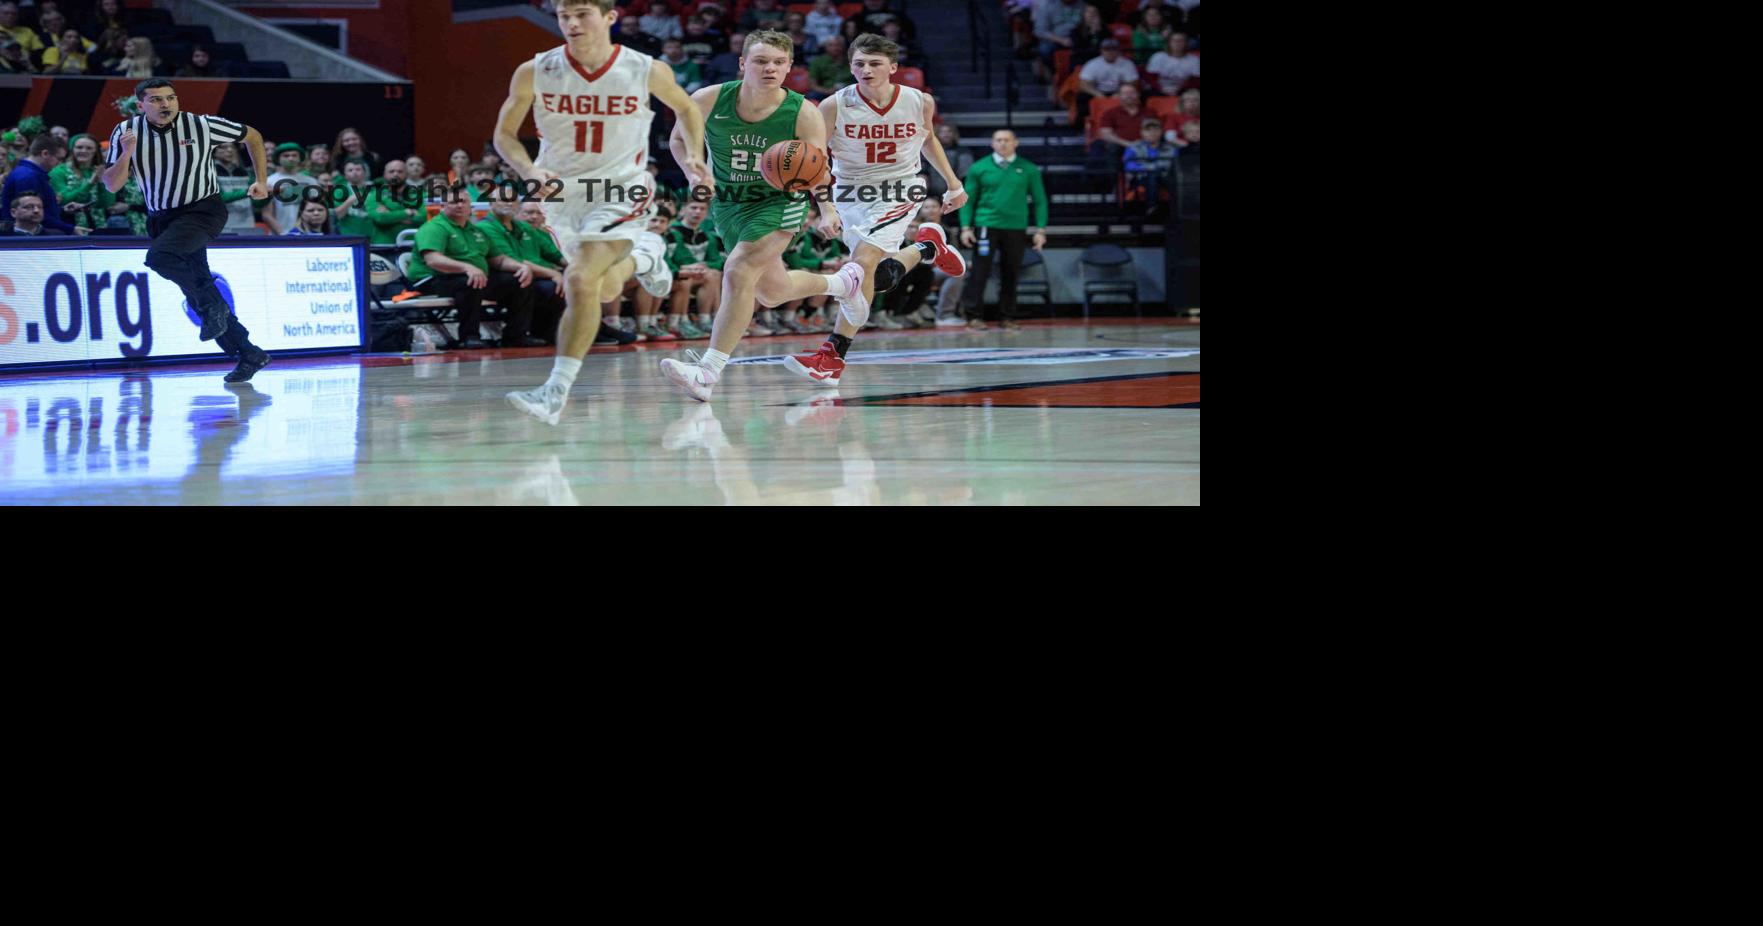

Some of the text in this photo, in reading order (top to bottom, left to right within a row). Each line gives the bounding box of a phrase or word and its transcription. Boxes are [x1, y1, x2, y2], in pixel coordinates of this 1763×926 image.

[541, 92, 639, 116] EAGLES
[573, 120, 604, 154] 11
[844, 122, 918, 140] EAGLES
[730, 134, 768, 149] SCALES
[730, 148, 763, 172] 21
[864, 141, 897, 164] 12
[306, 257, 351, 272] Laborers'
[285, 278, 352, 293] International
[310, 300, 353, 315] Union of
[282, 321, 356, 337] North America
